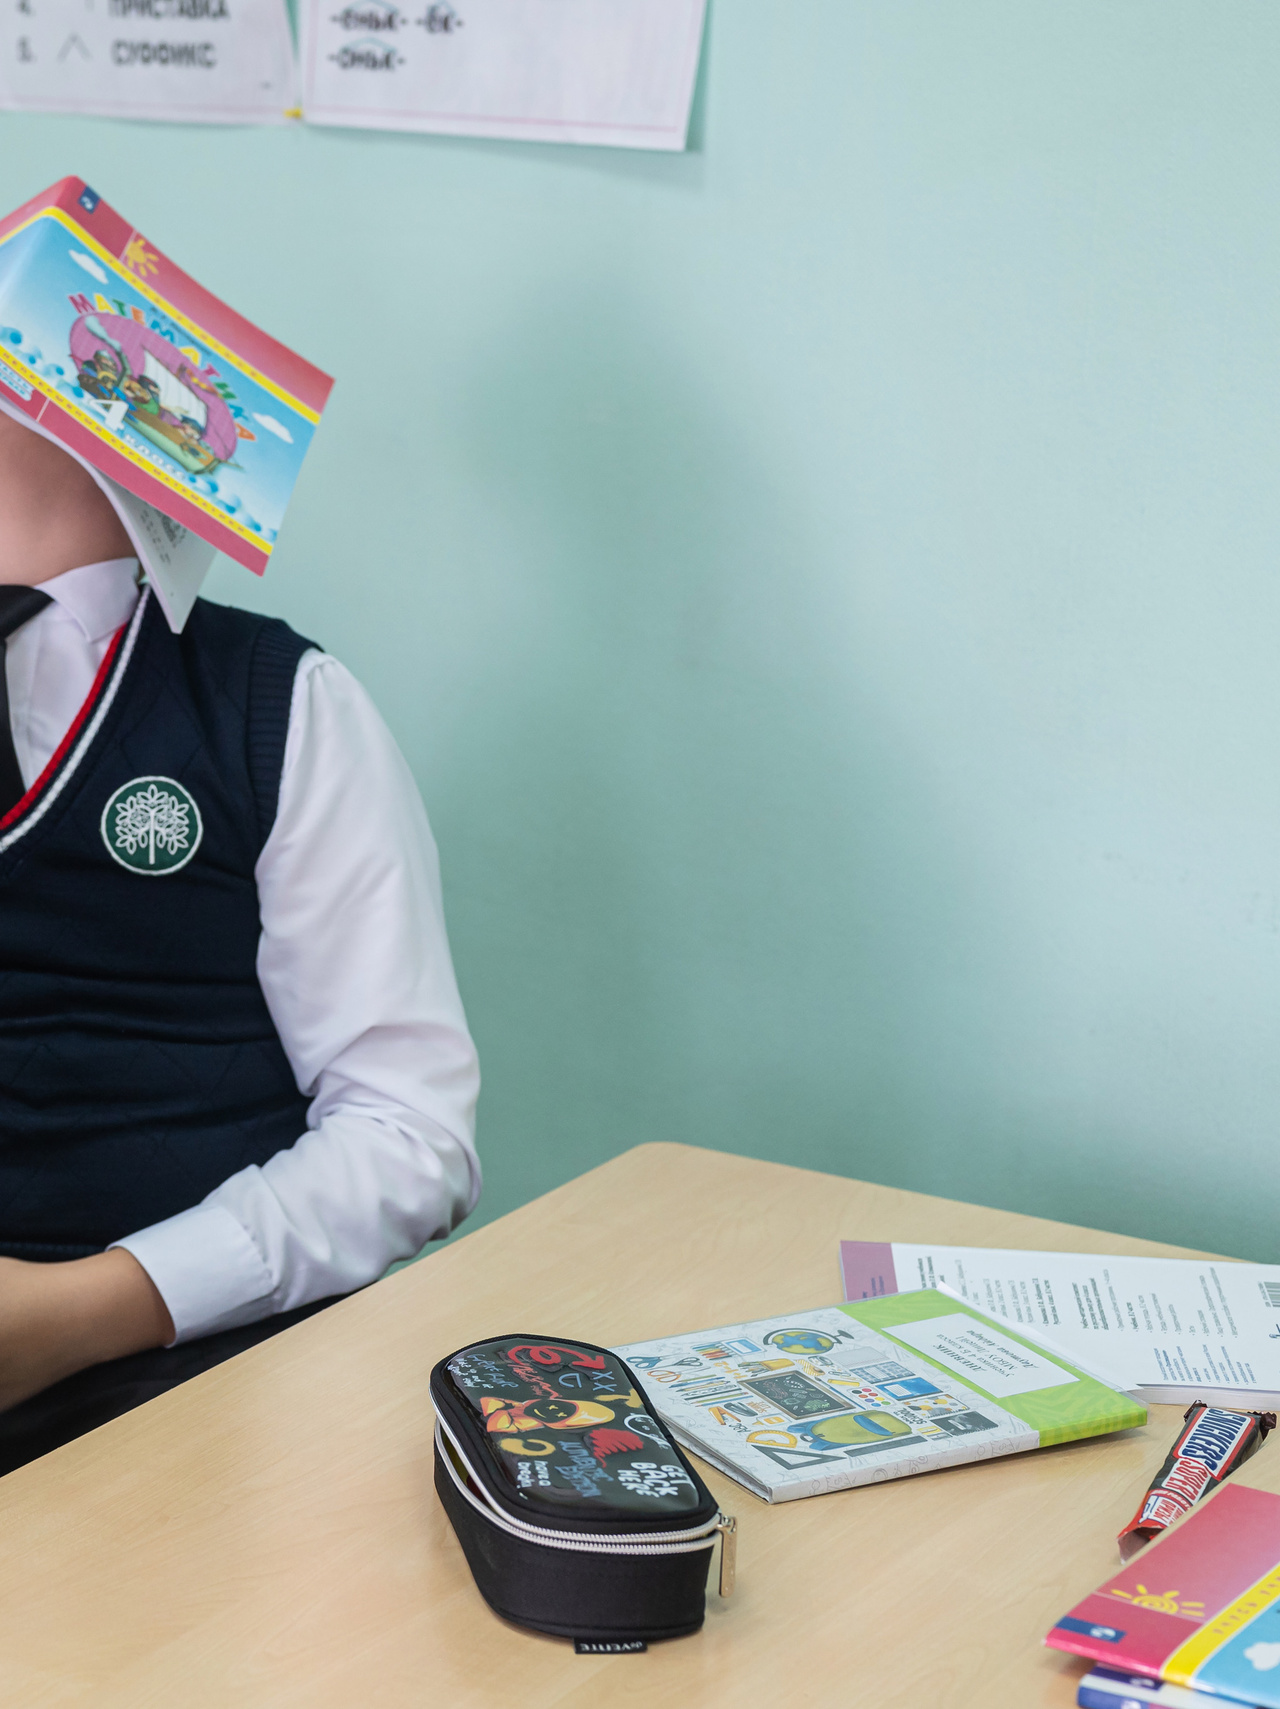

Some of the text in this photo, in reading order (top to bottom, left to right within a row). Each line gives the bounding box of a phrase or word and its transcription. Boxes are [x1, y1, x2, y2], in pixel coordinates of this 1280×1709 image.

[111, 39, 218, 69] СУФФИКС
[67, 292, 258, 444] МАТЕМАТИКА
[86, 398, 129, 431] 4
[933, 1343, 986, 1372] ДНЕВНИК
[1181, 1408, 1248, 1472] SNICKERS
[617, 1468, 660, 1499] HERE
[630, 1461, 679, 1497] BACK
[660, 1464, 692, 1489] GET
[1165, 1459, 1209, 1501] SUPER
